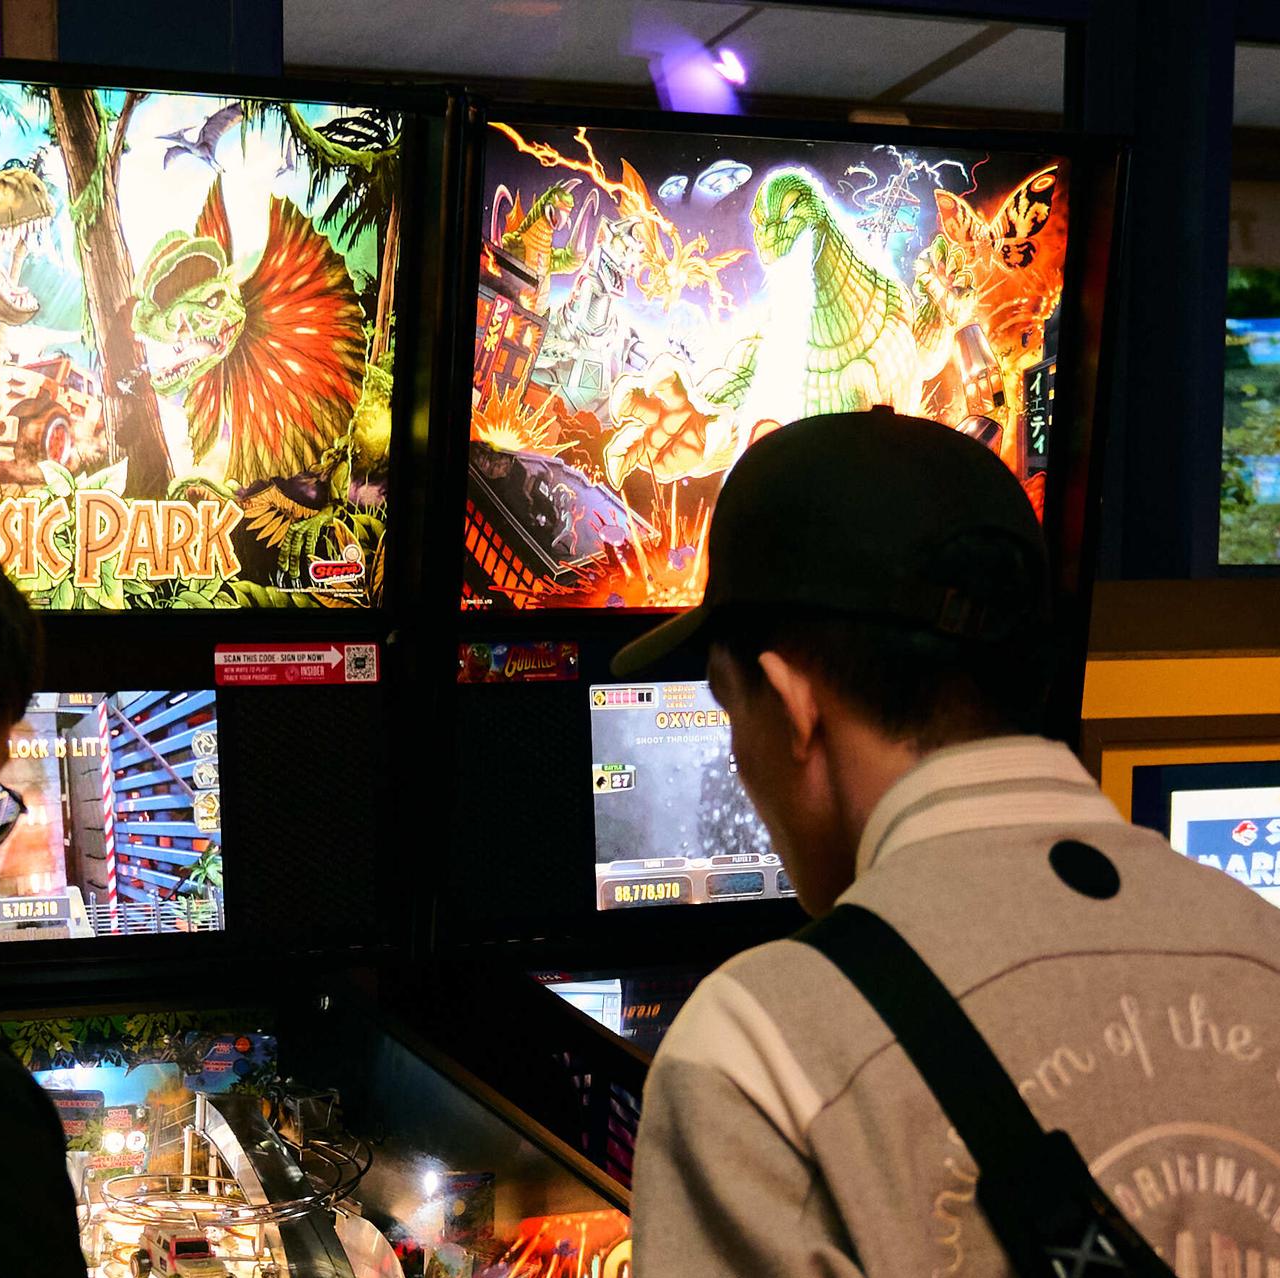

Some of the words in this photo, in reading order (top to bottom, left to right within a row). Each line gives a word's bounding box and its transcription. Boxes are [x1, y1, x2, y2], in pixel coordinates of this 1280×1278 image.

[76, 490, 242, 585] PARK
[315, 564, 358, 578] Stern
[224, 655, 241, 663] SCAN
[243, 655, 257, 663] THIS
[280, 654, 295, 662] SIGN
[307, 653, 325, 662] NOW!
[301, 666, 324, 677] INSIDER
[69, 694, 86, 704] BALL
[87, 694, 93, 704] 2
[656, 710, 731, 729] OXYGEN
[636, 736, 664, 745] SHOOT
[9, 738, 49, 758] LOCK
[54, 738, 67, 758] IS
[611, 774, 631, 788] 27
[1104, 994, 1154, 1078] of
[1167, 992, 1263, 1062] the
